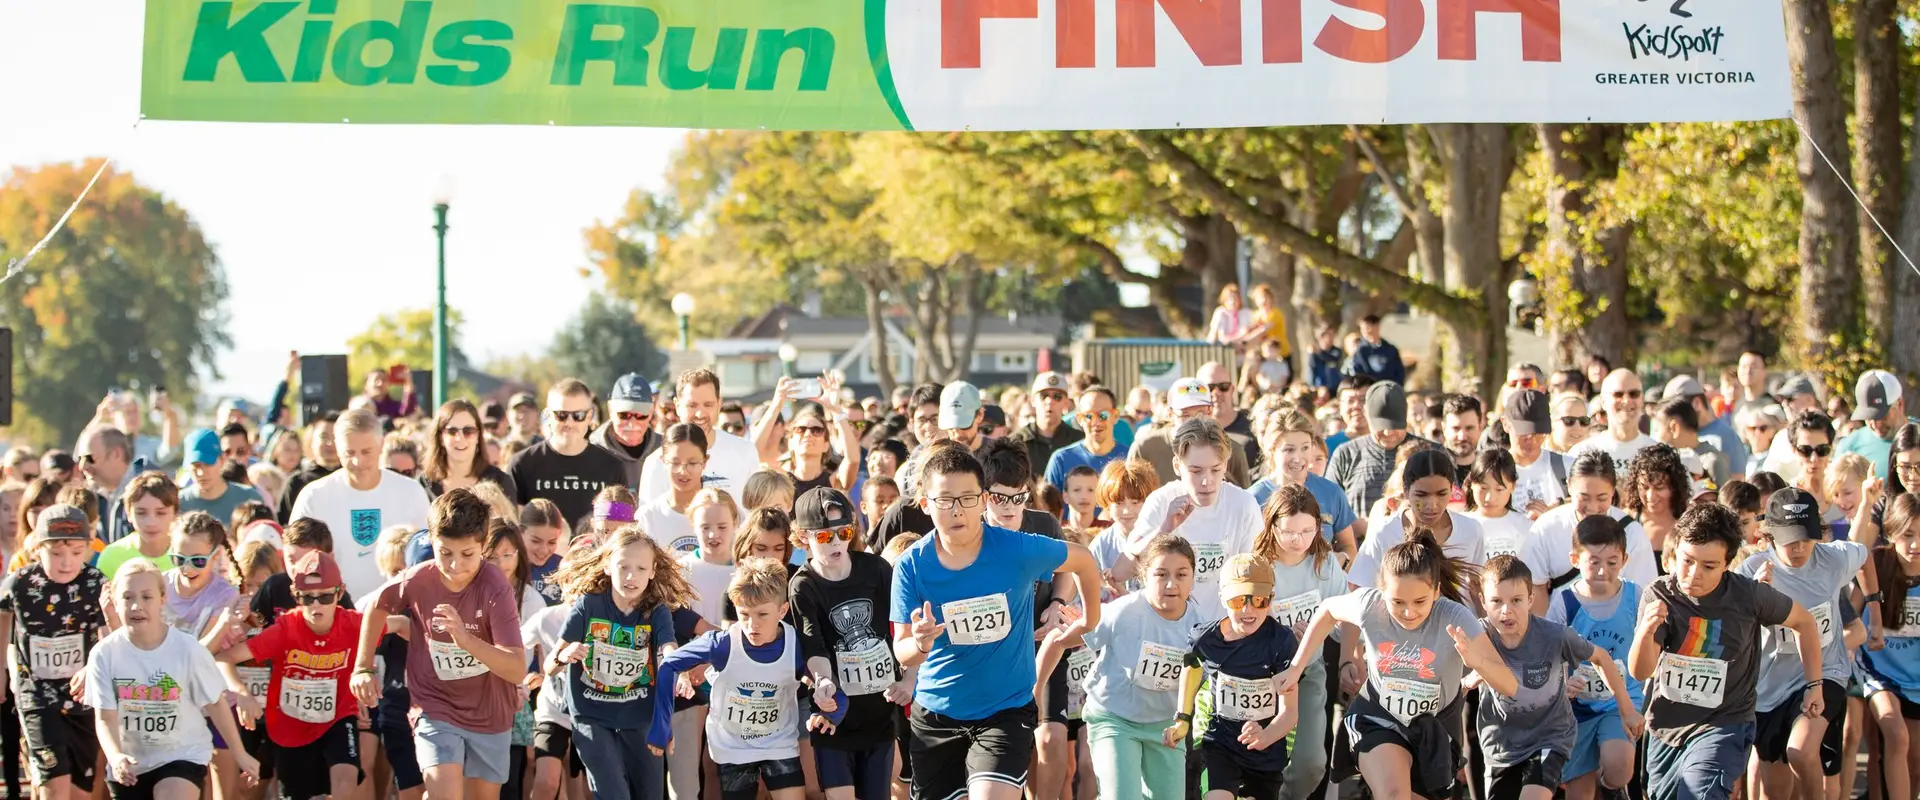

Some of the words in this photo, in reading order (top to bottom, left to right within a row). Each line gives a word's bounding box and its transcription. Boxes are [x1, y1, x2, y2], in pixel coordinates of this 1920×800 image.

[181, 0, 513, 87] Kids
[549, 3, 836, 92] Run
[1622, 21, 1725, 61] KidSport
[1595, 73, 1670, 85] GREATER
[1676, 71, 1756, 85] VICTORIA
[950, 610, 1006, 634] 11237
[35, 649, 82, 668] 11072
[435, 655, 482, 669] 1132
[843, 657, 892, 683] 11185
[1141, 658, 1181, 680] 1129
[740, 681, 778, 690] VICTORIA
[1665, 670, 1722, 694] 11477
[285, 692, 333, 712] 11356
[1220, 689, 1273, 709] 11332
[1385, 695, 1439, 717] 11096
[123, 715, 177, 732] 11087
[727, 706, 779, 725] 11438
